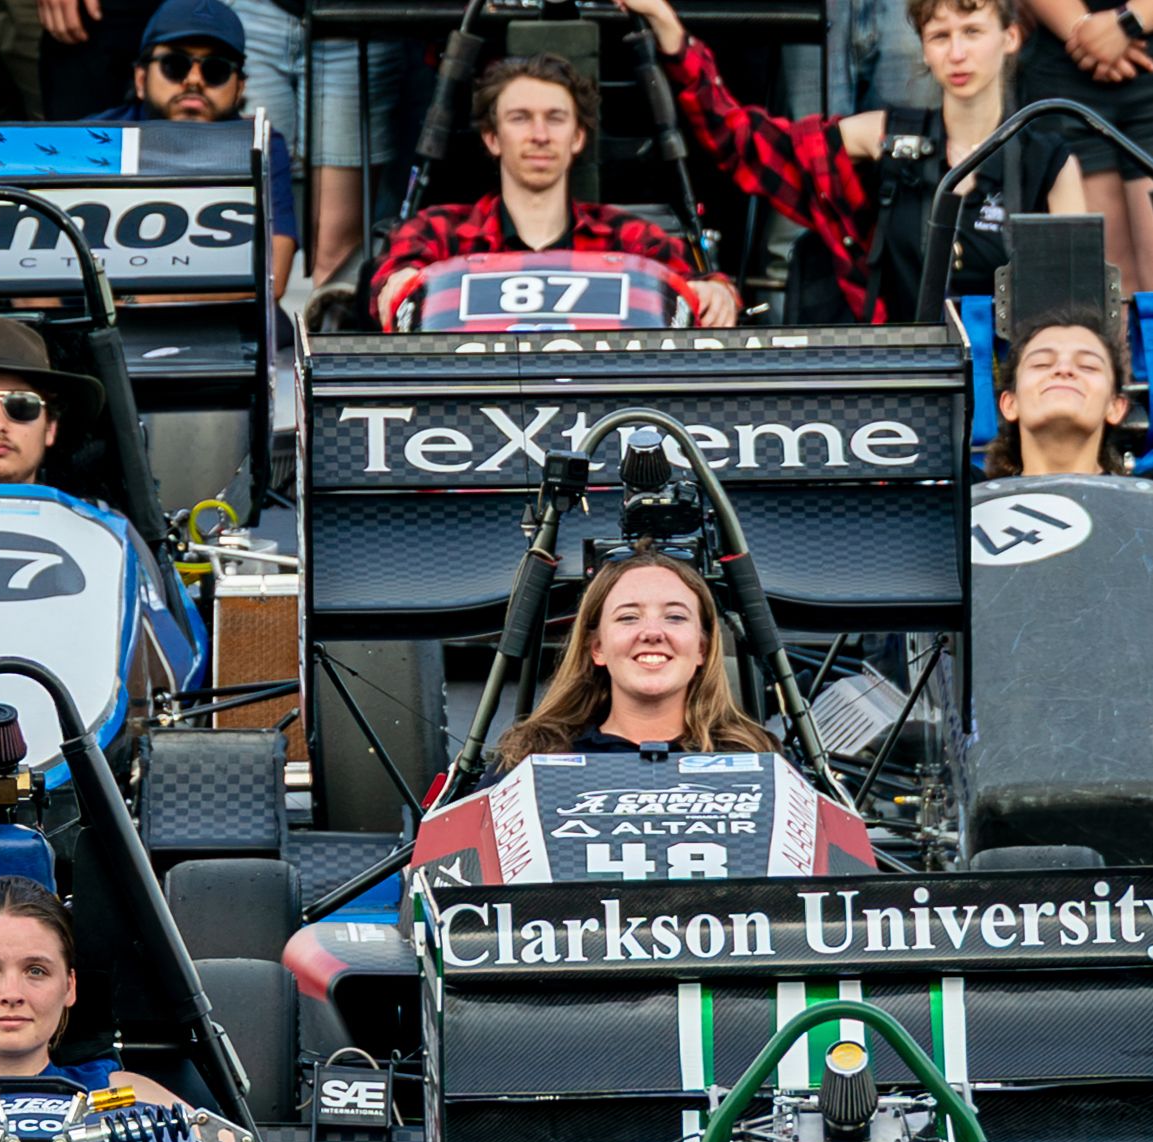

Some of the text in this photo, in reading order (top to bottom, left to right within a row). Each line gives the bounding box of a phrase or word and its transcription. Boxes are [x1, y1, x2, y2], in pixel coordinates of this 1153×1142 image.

[499, 276, 590, 313] 87
[339, 406, 919, 472] TeXtreme
[971, 503, 1072, 556] 41
[613, 802, 760, 815] RACING
[618, 792, 763, 804] CRIMSON
[611, 821, 757, 835] ALTAIR
[439, 881, 1153, 967] Clarkson Universit
[320, 1079, 386, 1109] SAE
[320, 1108, 384, 1116] INTERNATIONAL
